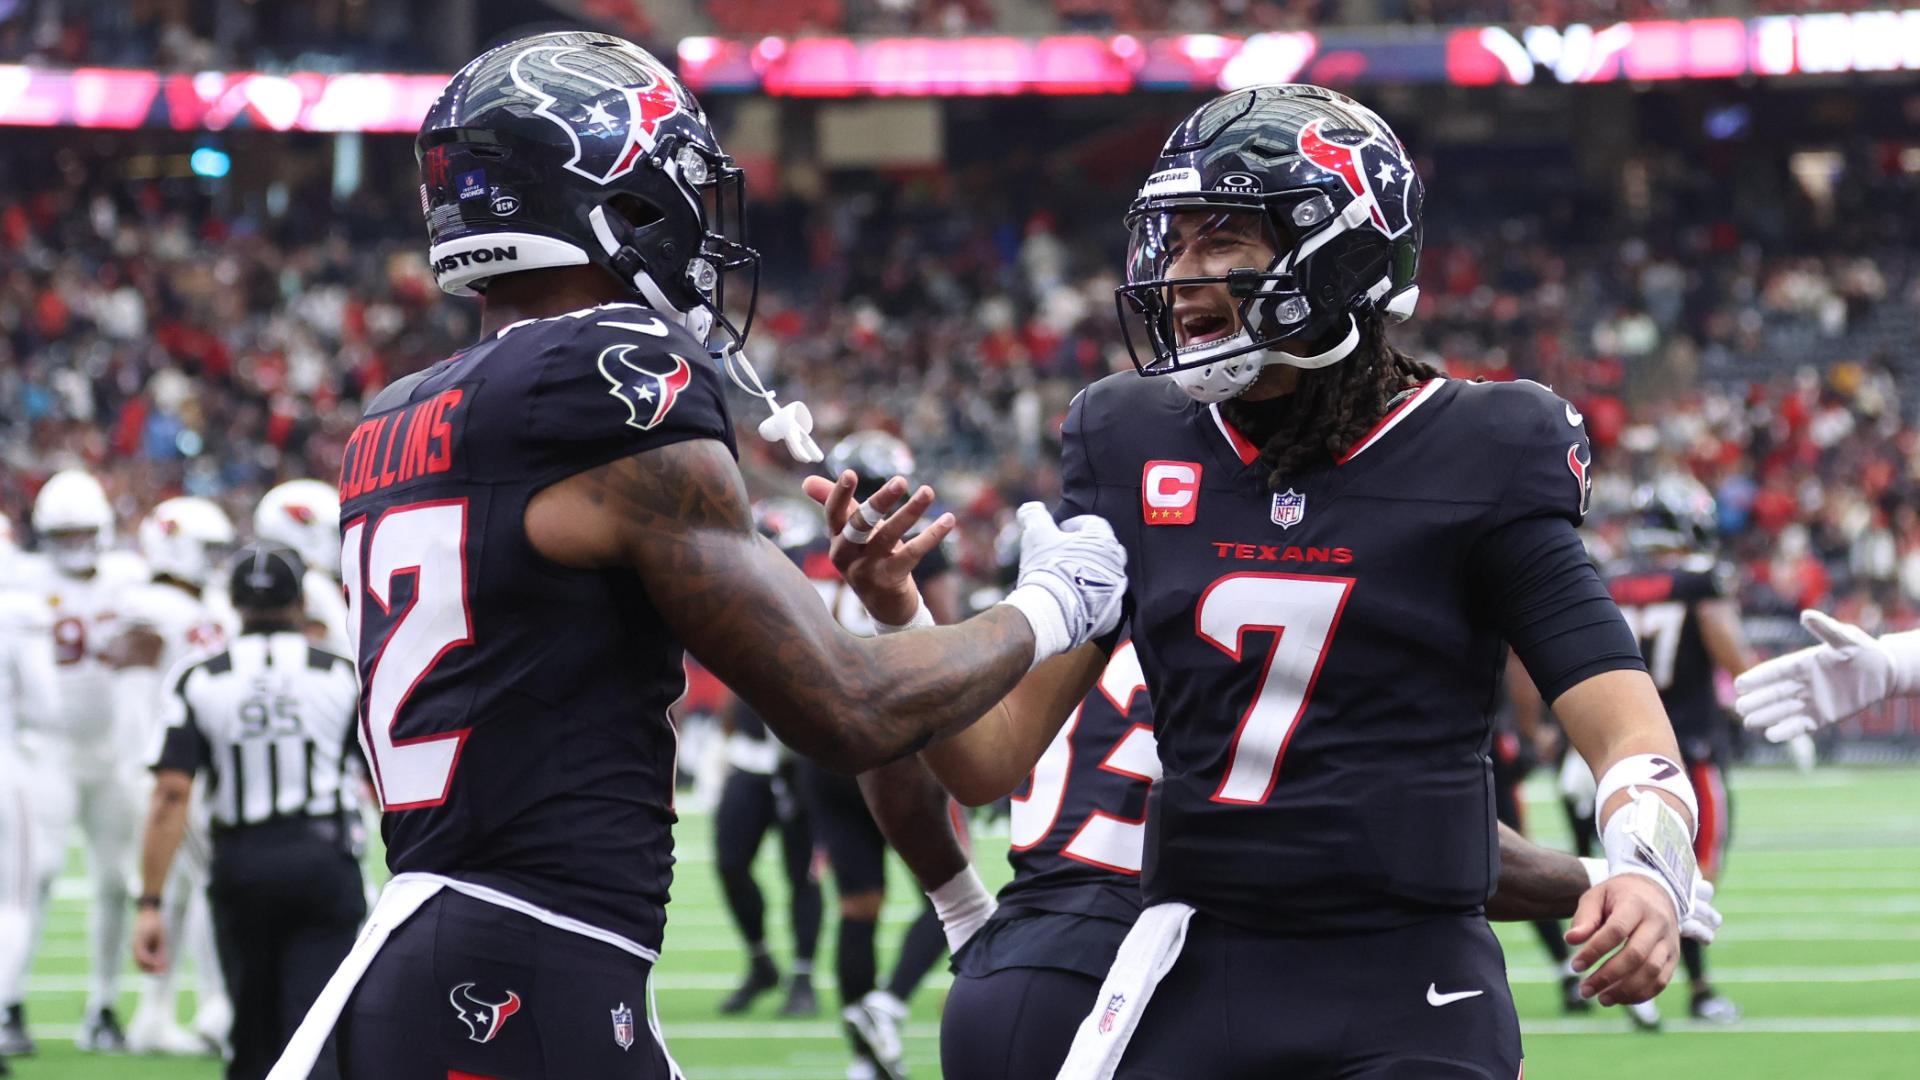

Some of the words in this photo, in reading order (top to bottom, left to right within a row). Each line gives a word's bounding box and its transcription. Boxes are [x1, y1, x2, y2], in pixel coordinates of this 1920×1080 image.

[339, 389, 463, 504] COLLINS
[1146, 465, 1195, 507] C
[1276, 506, 1297, 521] NFL
[1211, 542, 1353, 564] TEXANS
[1195, 571, 1357, 805] 7
[238, 695, 303, 737] 95
